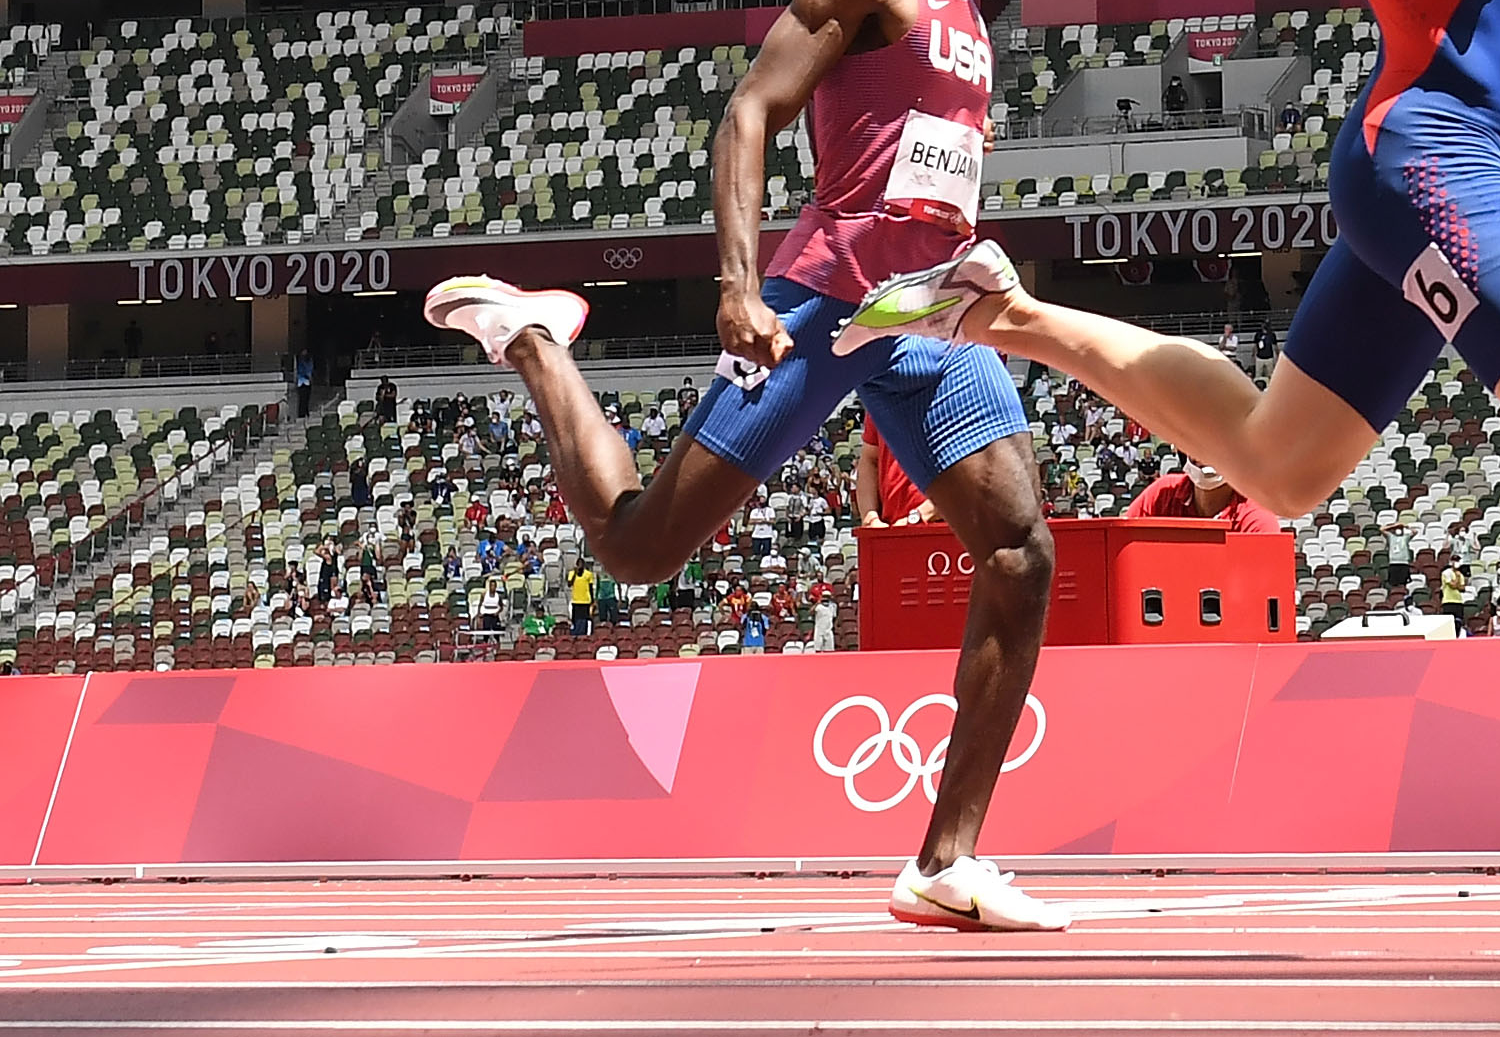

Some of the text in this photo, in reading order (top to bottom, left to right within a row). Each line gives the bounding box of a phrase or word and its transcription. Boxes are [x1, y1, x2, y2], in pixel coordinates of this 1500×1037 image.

[928, 19, 993, 93] USA
[1195, 38, 1221, 48] TOKYO
[437, 84, 461, 93] TOKYO
[1065, 204, 1340, 259] TOKYO 2020
[130, 249, 390, 302] TOKYO 2020
[1415, 268, 1458, 324] 6
